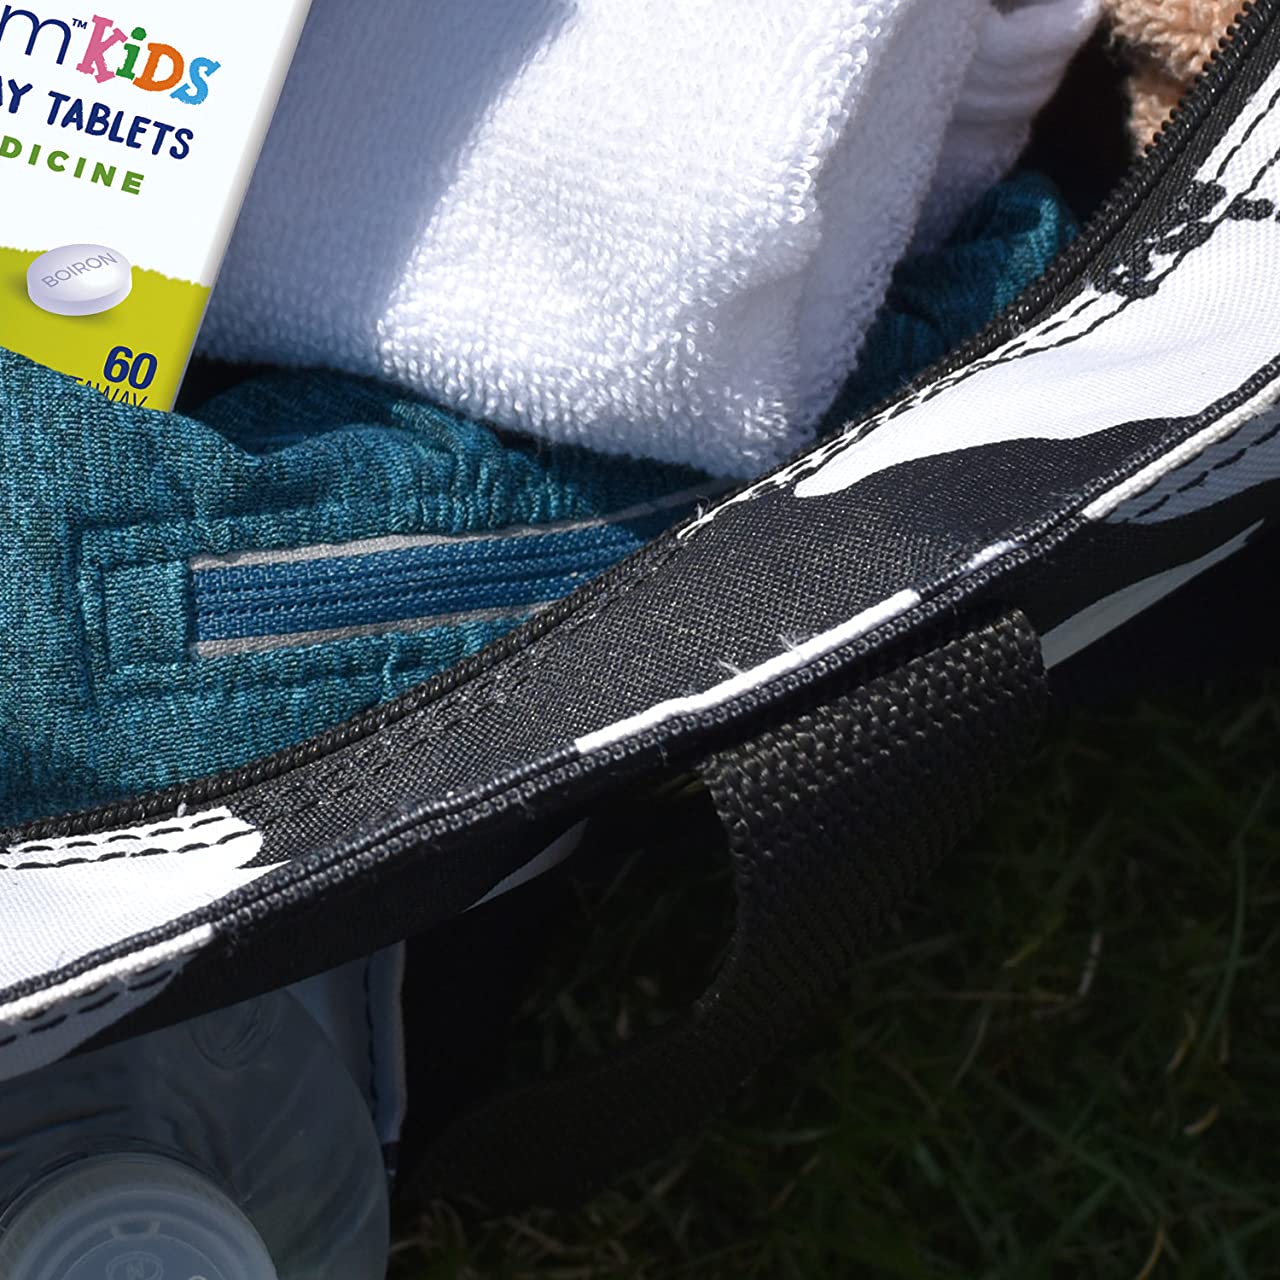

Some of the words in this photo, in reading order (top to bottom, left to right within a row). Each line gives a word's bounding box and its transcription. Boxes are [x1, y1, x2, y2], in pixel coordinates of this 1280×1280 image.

[46, 90, 195, 161] TABLETS
[41, 252, 118, 288] BOIRON
[103, 345, 158, 389] 60
